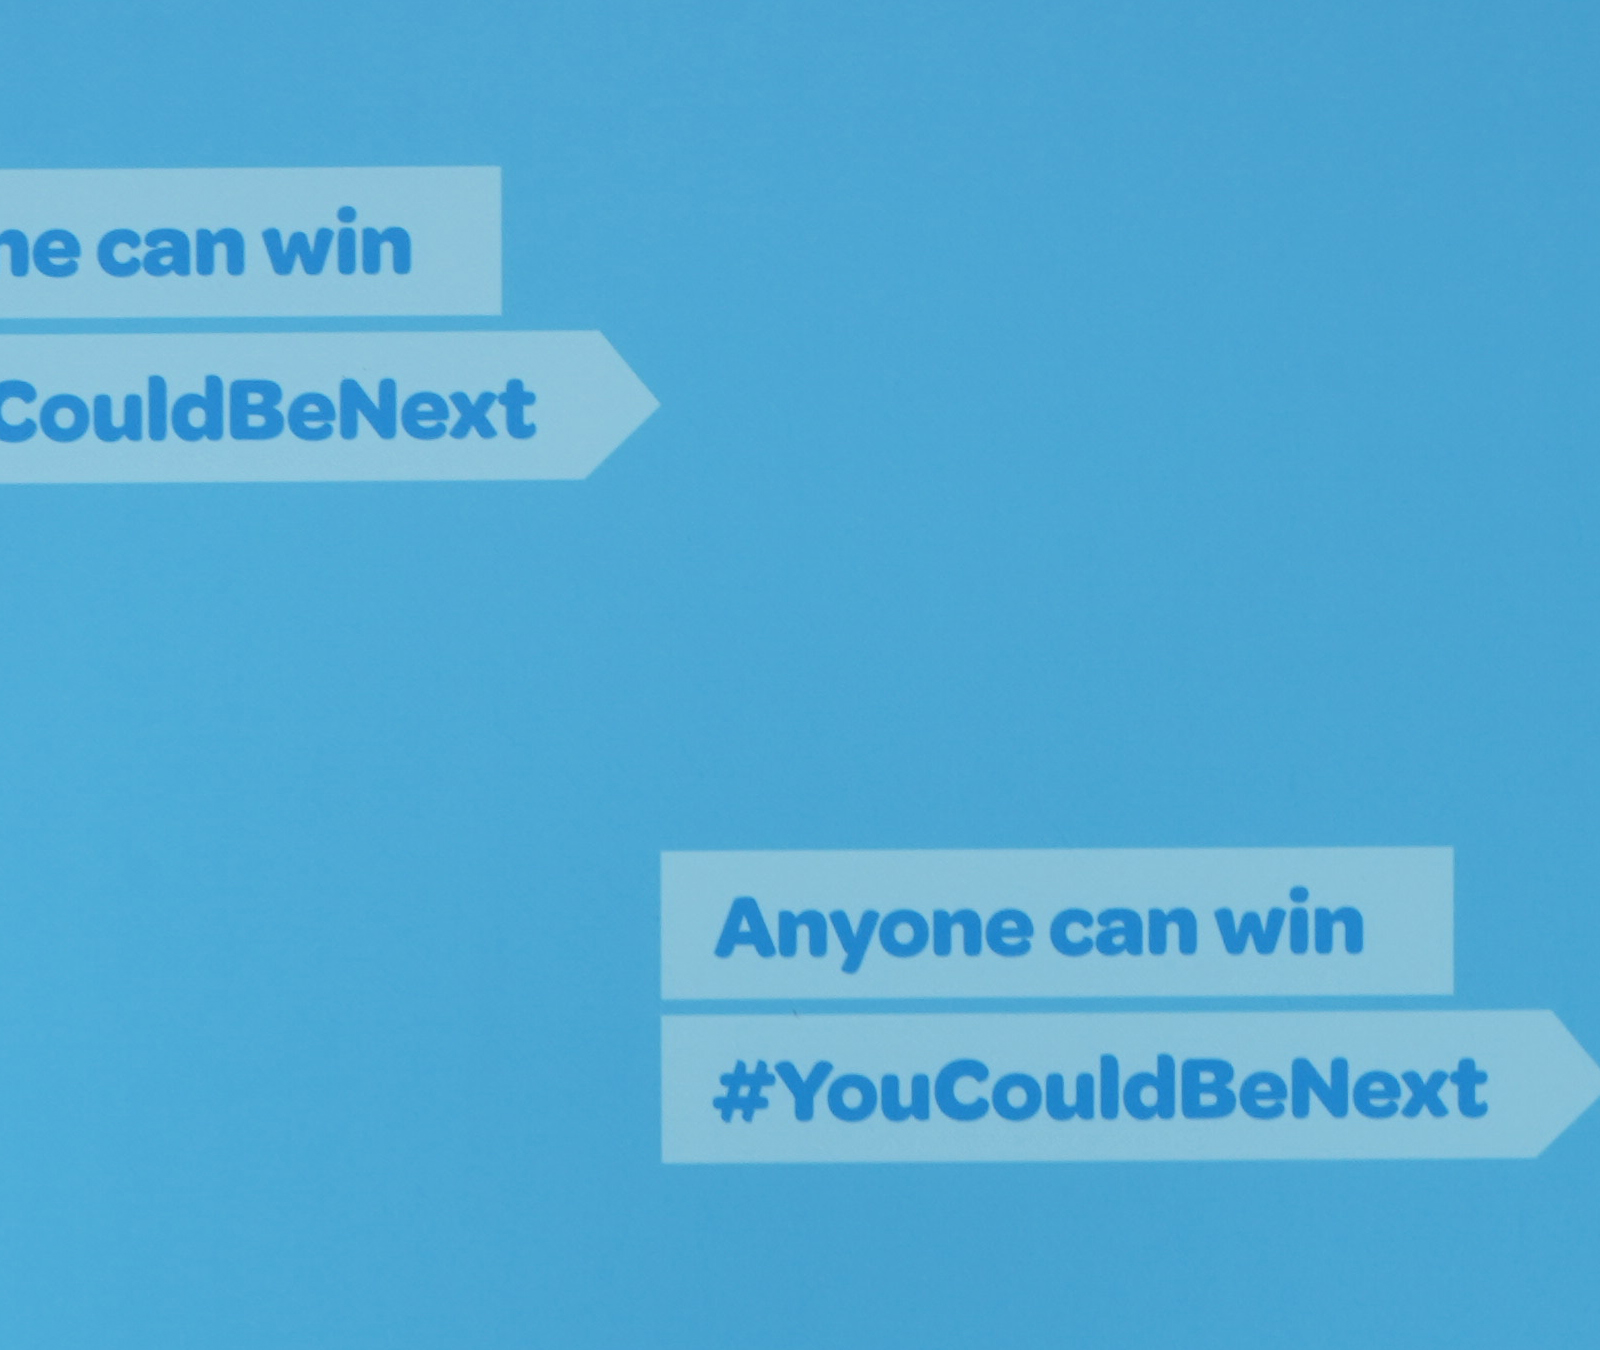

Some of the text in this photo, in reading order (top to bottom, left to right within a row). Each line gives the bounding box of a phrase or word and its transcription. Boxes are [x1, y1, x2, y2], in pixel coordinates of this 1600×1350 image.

[97, 227, 245, 277] can
[262, 206, 411, 275] win
[715, 886, 1364, 974] Anyone can win
[713, 1053, 1488, 1122] #YouCouldBeNext
